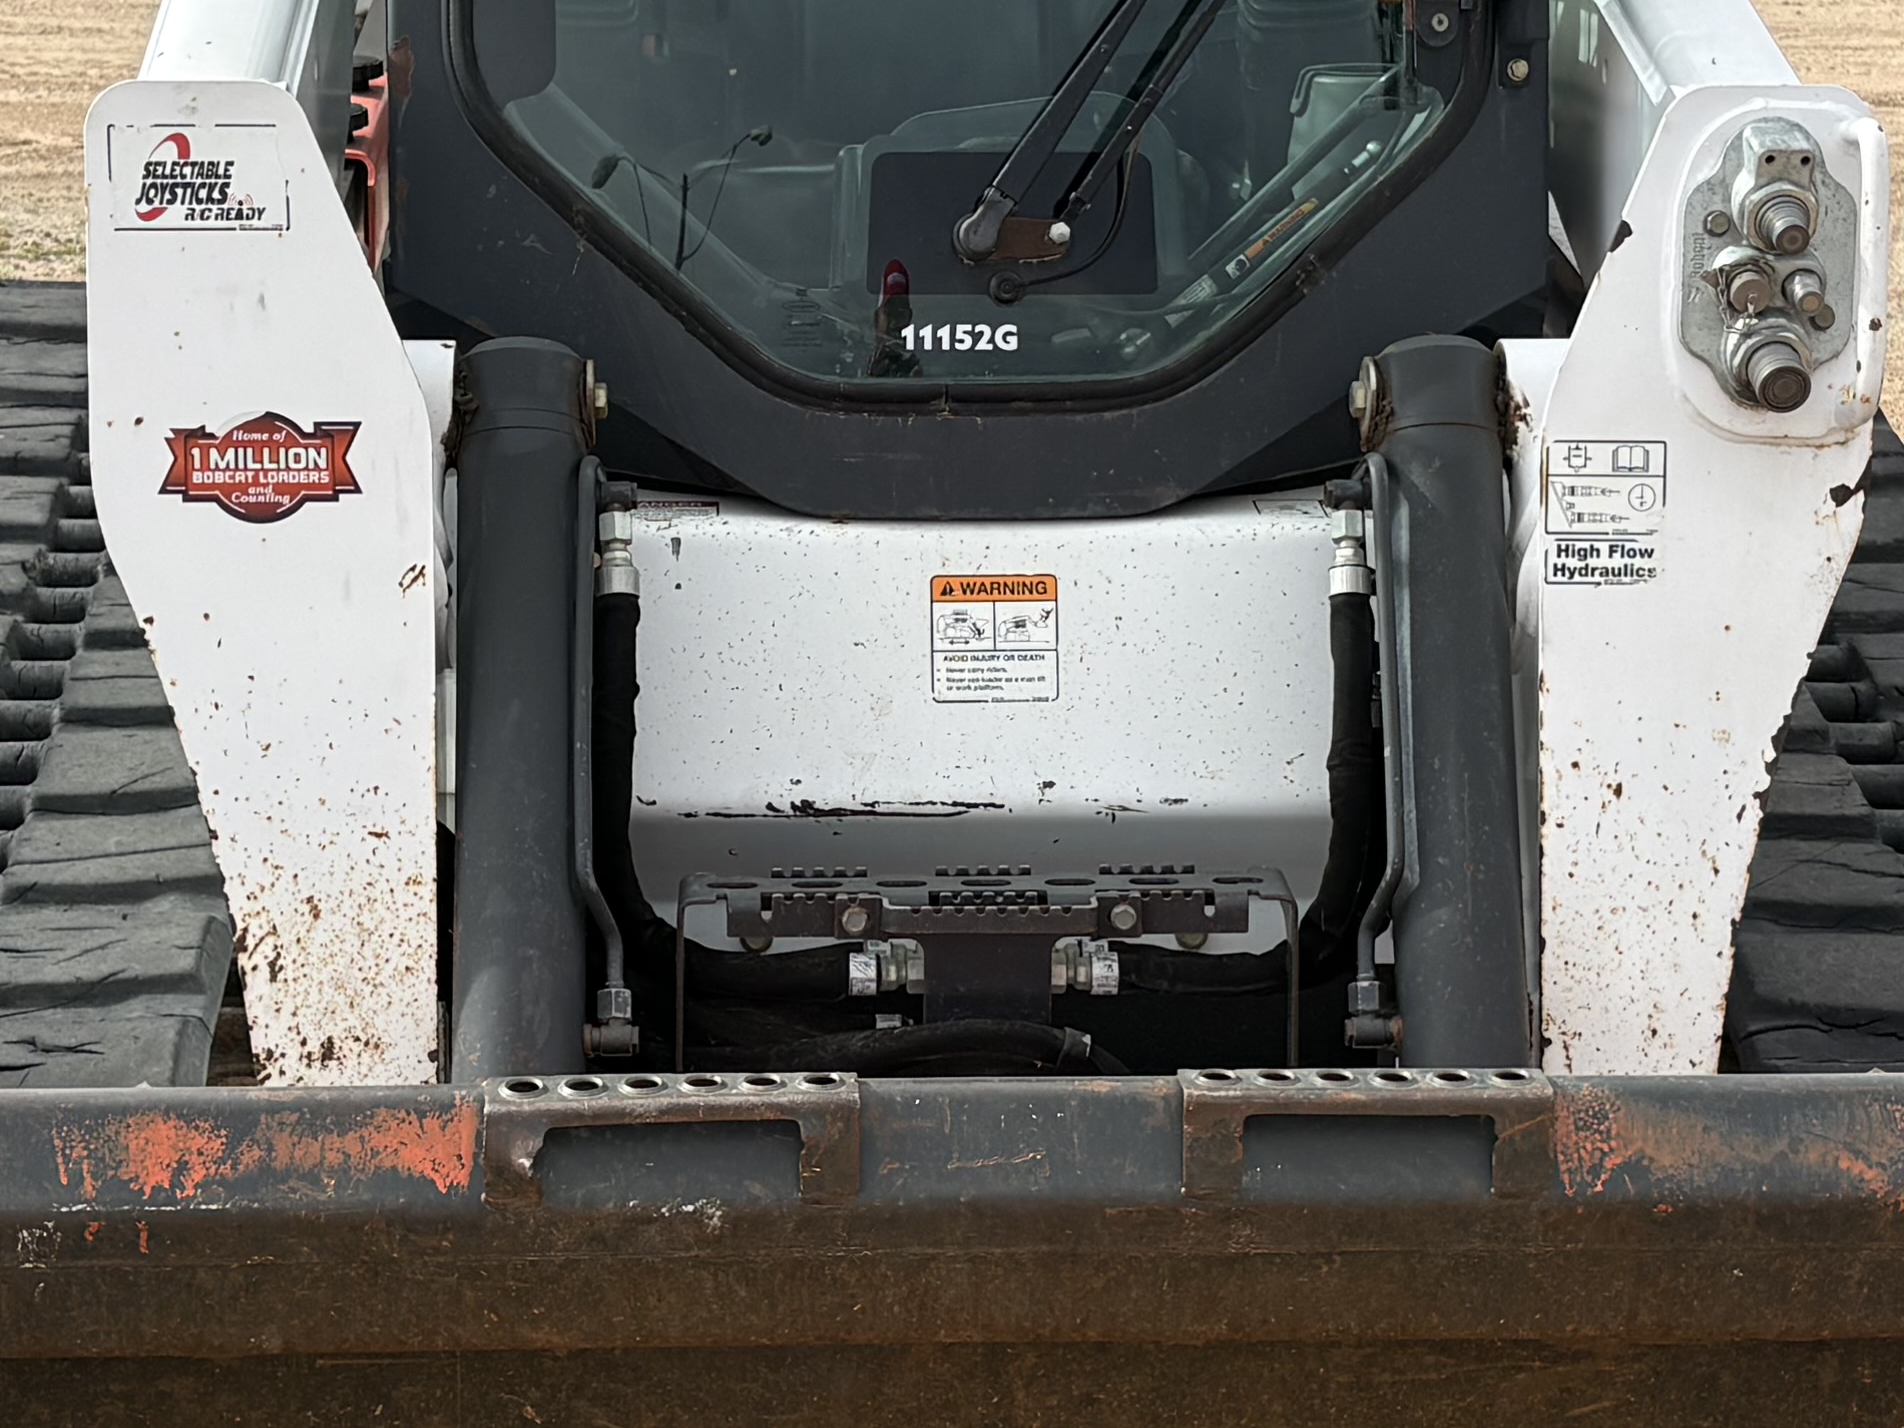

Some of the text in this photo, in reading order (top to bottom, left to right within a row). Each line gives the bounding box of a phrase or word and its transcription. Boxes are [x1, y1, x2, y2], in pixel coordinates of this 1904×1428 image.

[141, 160, 235, 180] SELECTABLE
[134, 181, 231, 206] JOYSTICKS
[214, 206, 267, 222] READY
[900, 323, 1018, 352] 11152G
[232, 429, 287, 443] Home of
[190, 446, 328, 470] 1 MILLION
[192, 471, 330, 484] BOBCAT LOADERS
[248, 484, 273, 494] and
[231, 492, 291, 505] Counting
[1556, 543, 1655, 562] High Flow
[1552, 562, 1657, 580] Hydraulics
[959, 580, 1048, 596] WARNING
